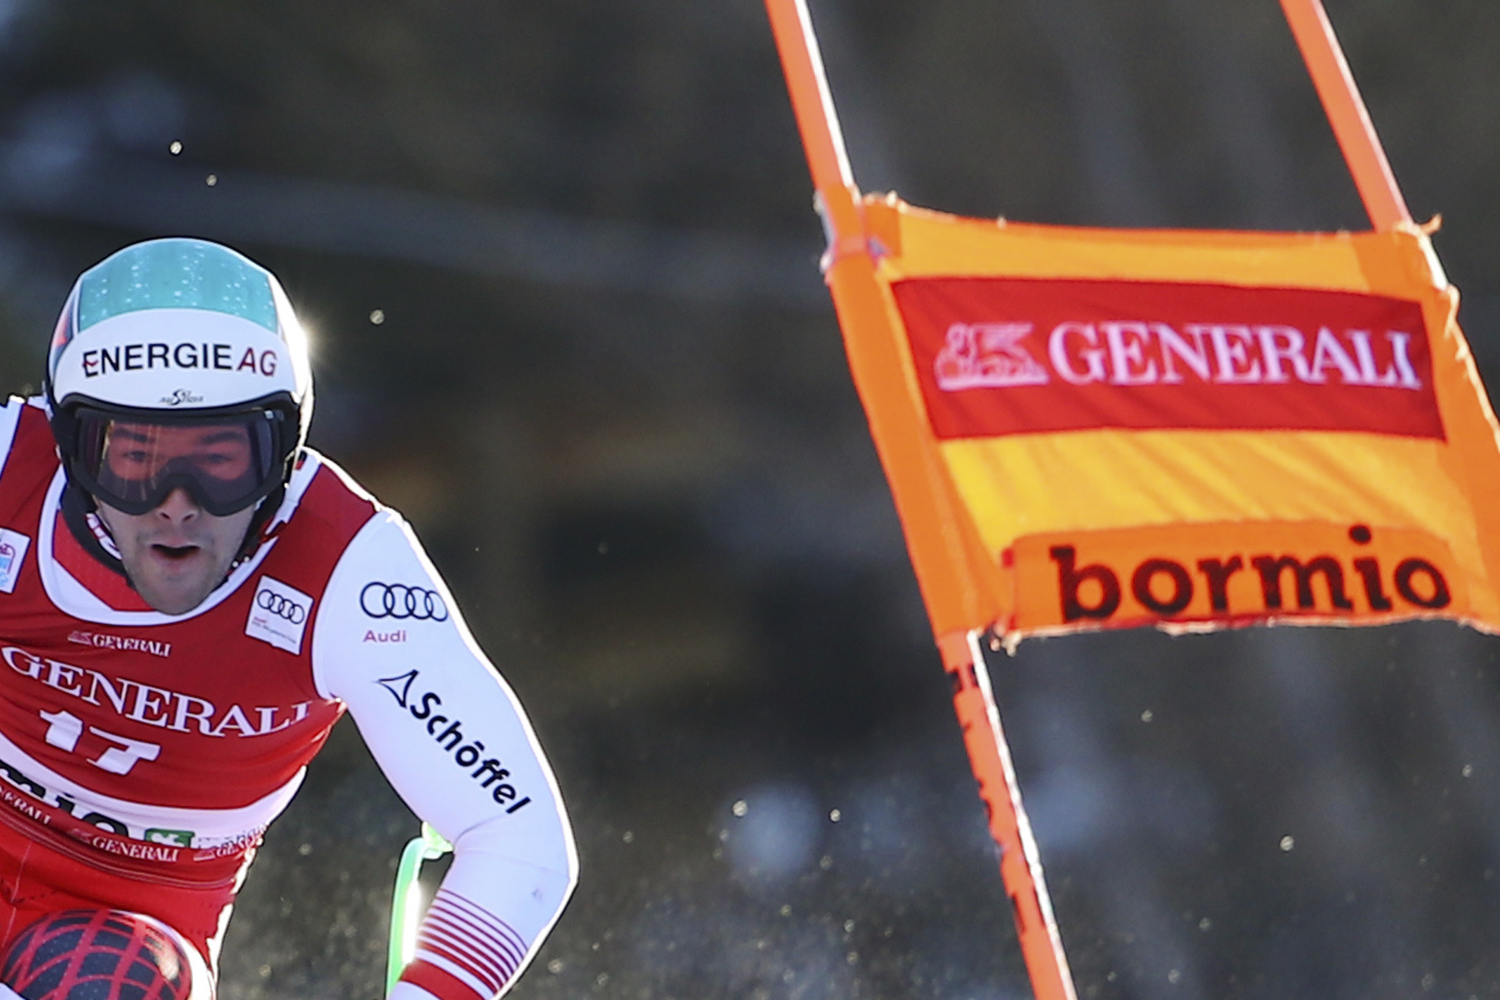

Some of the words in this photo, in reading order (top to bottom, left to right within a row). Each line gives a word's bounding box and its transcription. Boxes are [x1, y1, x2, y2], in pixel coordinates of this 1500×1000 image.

[1047, 320, 1423, 390] GENERALI
[1049, 524, 1452, 624] bormio
[92, 634, 172, 657] GENERALI
[362, 629, 407, 643] Audi
[0, 646, 313, 738] GENERALI
[39, 709, 162, 776] 17
[409, 691, 532, 814] Schöffel
[92, 836, 180, 862] GENERALI
